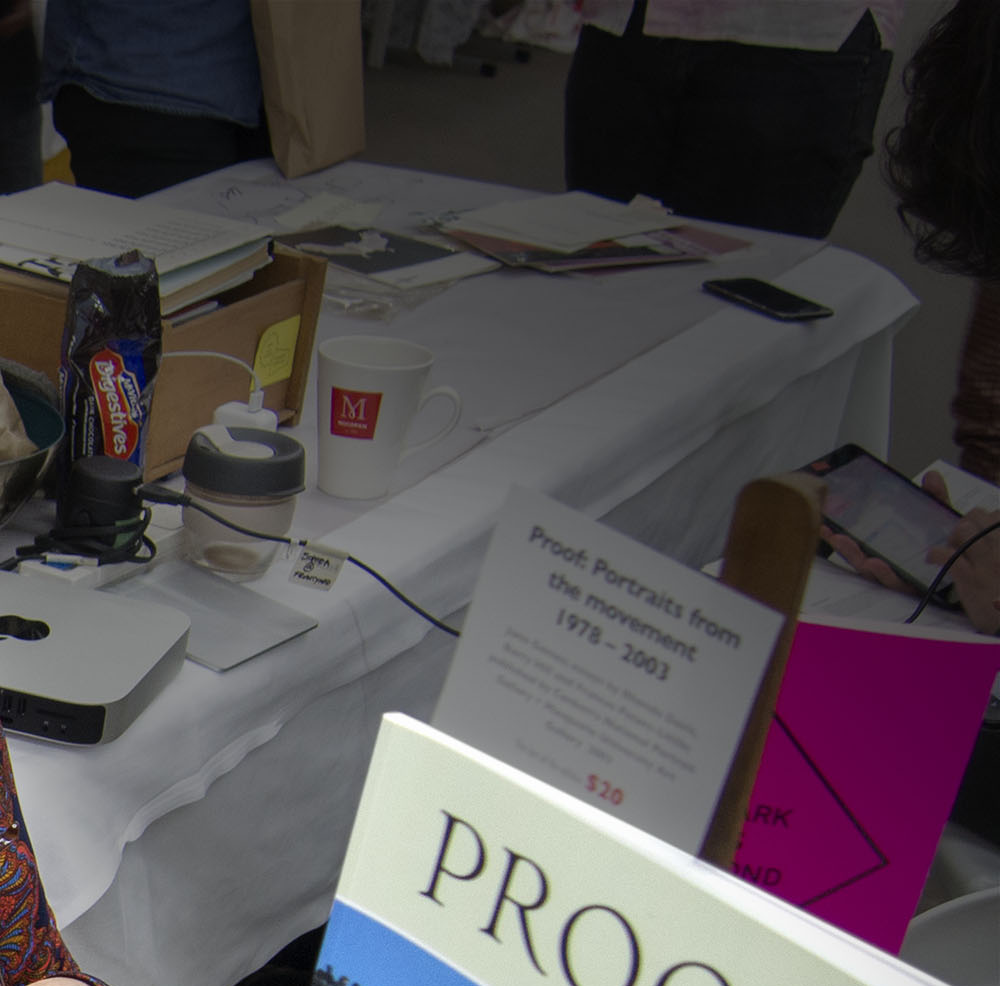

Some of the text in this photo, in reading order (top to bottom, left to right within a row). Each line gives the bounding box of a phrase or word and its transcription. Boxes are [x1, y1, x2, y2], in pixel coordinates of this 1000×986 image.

[95, 360, 127, 455] Digestives
[340, 394, 367, 420] M
[529, 525, 741, 649] Proof: Portraits from
[549, 572, 697, 663] the movement
[556, 608, 602, 645] 1978
[621, 643, 671, 681] 2003
[585, 773, 625, 806] $20
[745, 804, 793, 829] RK
